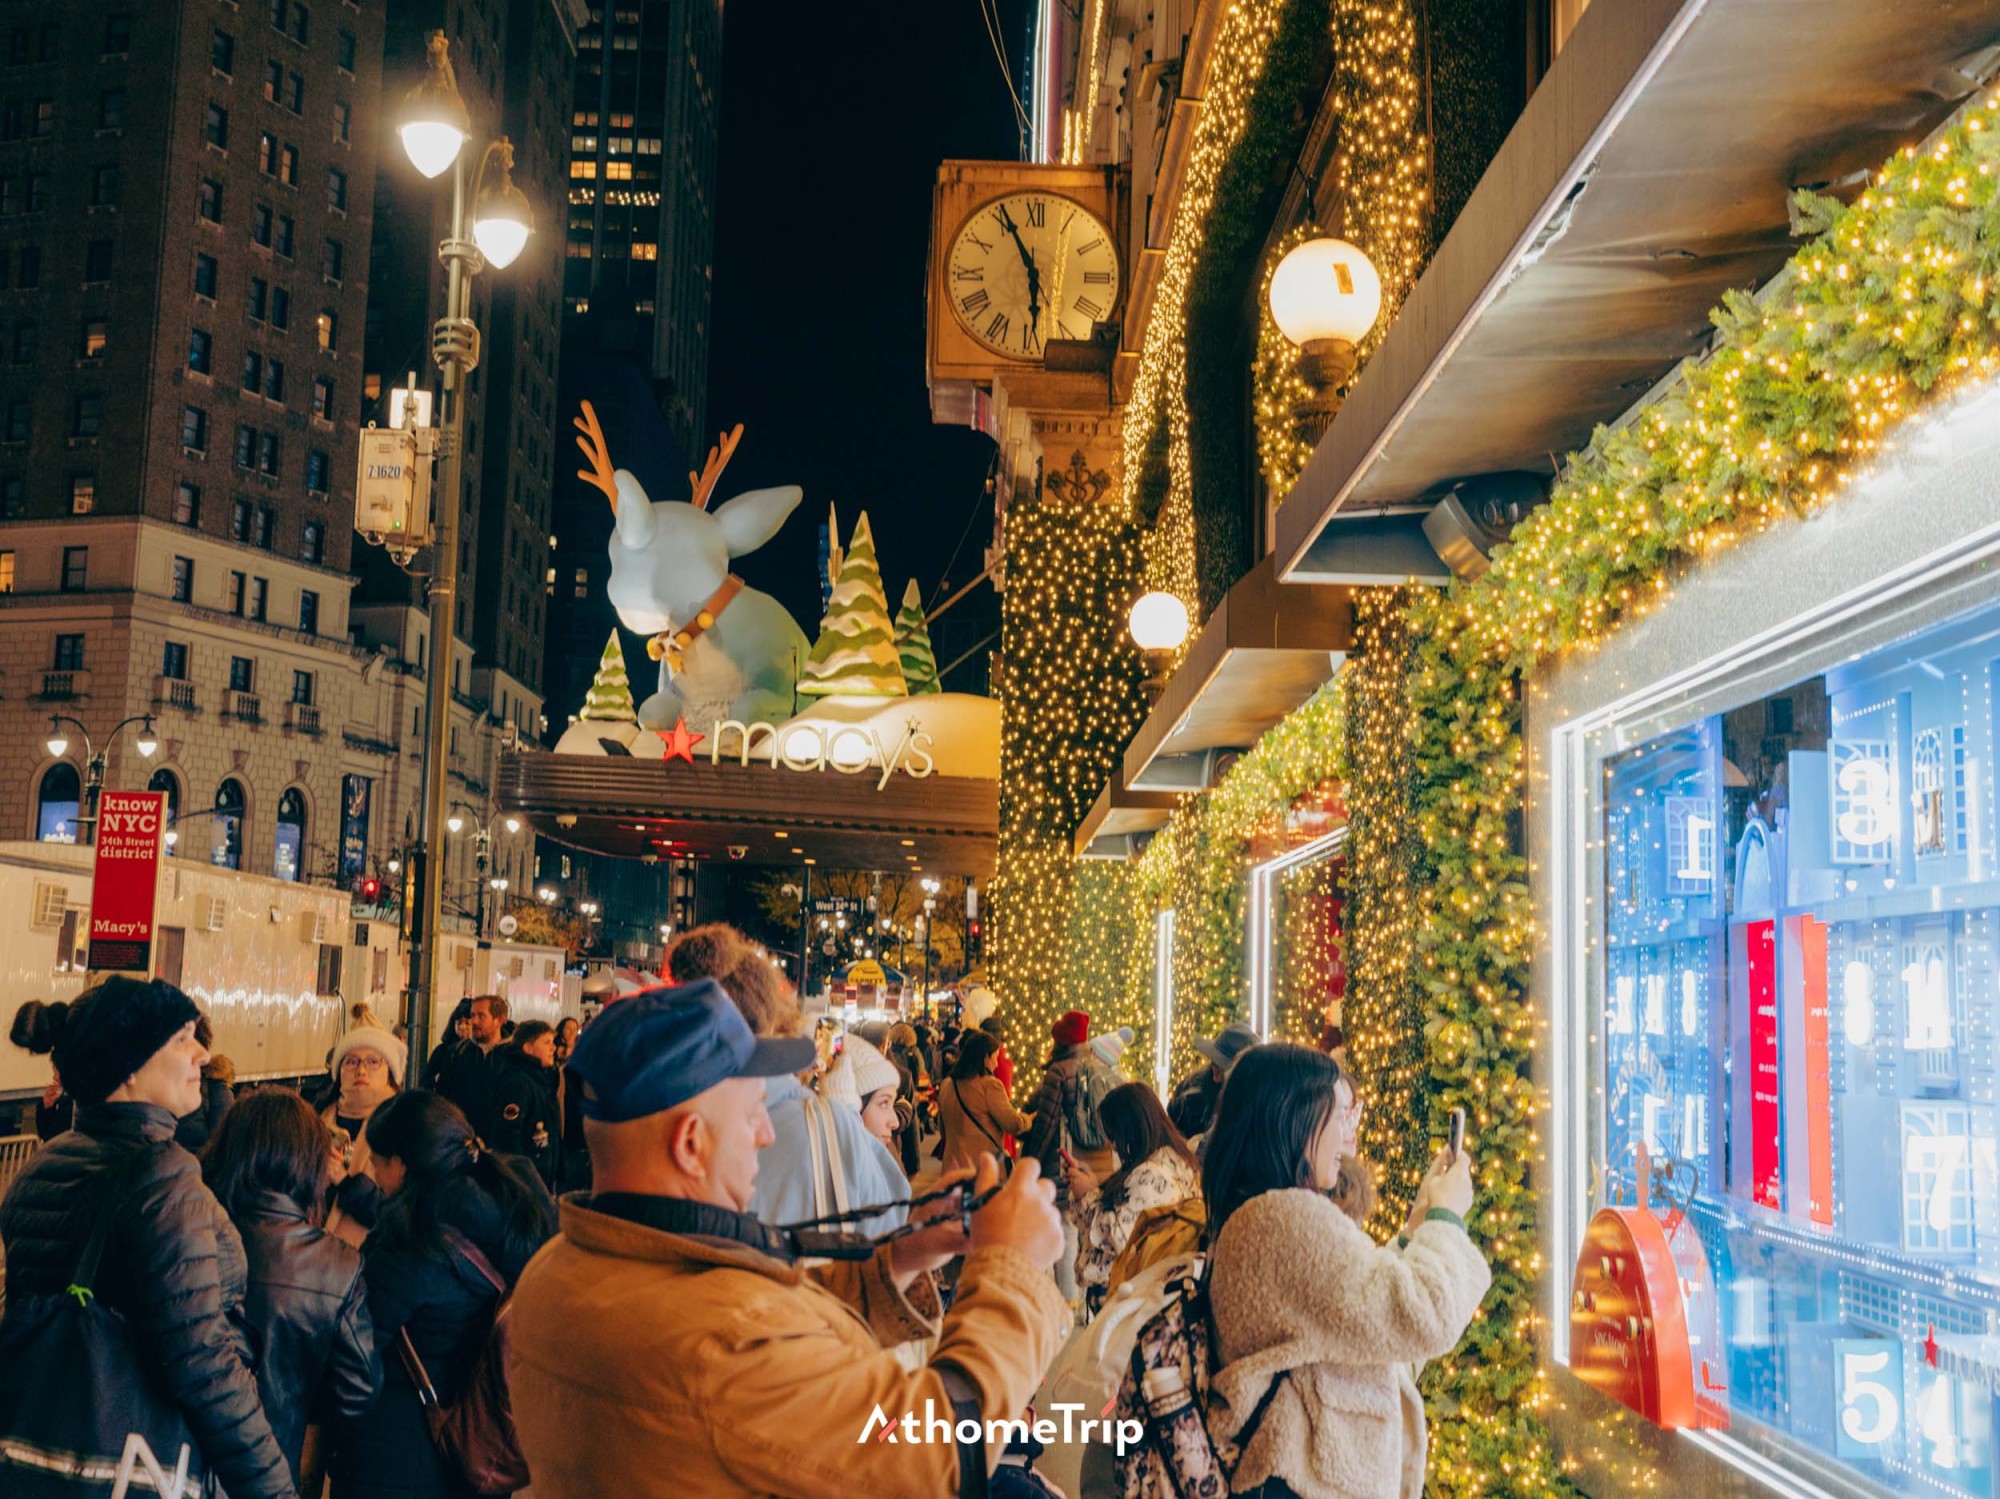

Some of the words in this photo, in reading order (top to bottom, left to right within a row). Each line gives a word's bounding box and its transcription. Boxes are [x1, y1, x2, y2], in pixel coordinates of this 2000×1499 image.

[991, 204, 1017, 236] X
[1026, 202, 1045, 228] XII
[967, 232, 993, 255] X
[712, 716, 935, 791] macy's
[103, 795, 158, 812] know
[1838, 759, 1893, 846] 3
[102, 814, 157, 833] NYC
[101, 836, 122, 846] 34th
[125, 837, 154, 847] Street
[100, 846, 154, 860] district
[816, 901, 834, 911] West
[850, 902, 858, 912] St
[94, 919, 148, 937] Macy's
[1842, 1351, 1899, 1443] 5
